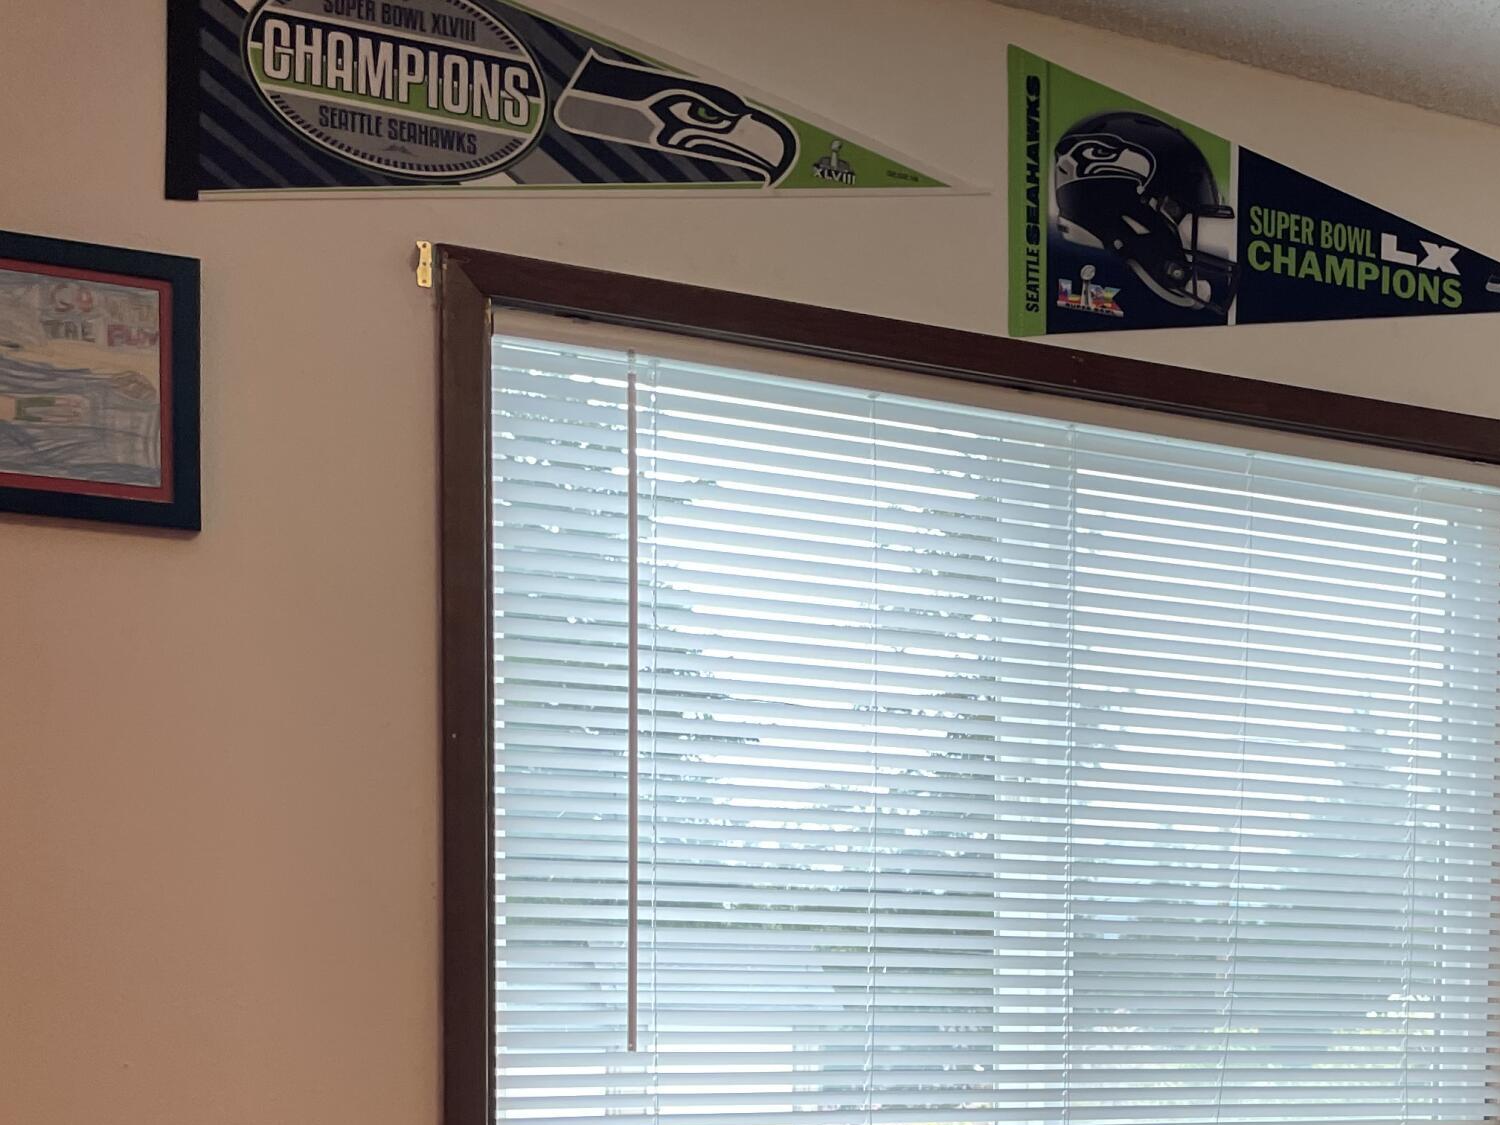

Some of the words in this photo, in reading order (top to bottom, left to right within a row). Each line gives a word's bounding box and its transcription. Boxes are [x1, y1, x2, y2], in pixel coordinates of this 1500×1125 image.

[381, 3, 425, 33] BOWL
[431, 12, 477, 42] XLVIII
[263, 18, 531, 126] CHAMPIONS
[318, 105, 383, 138] SEATTLE
[387, 116, 478, 155] SEAHAWKS
[1025, 75, 1041, 246] SEAHAWKS
[1247, 240, 1463, 309] CHAMPIONS
[1250, 206, 1315, 246] SUPER
[1320, 220, 1377, 259] BOWL
[1381, 232, 1461, 276] LX
[1025, 247, 1040, 313] SEATTLE
